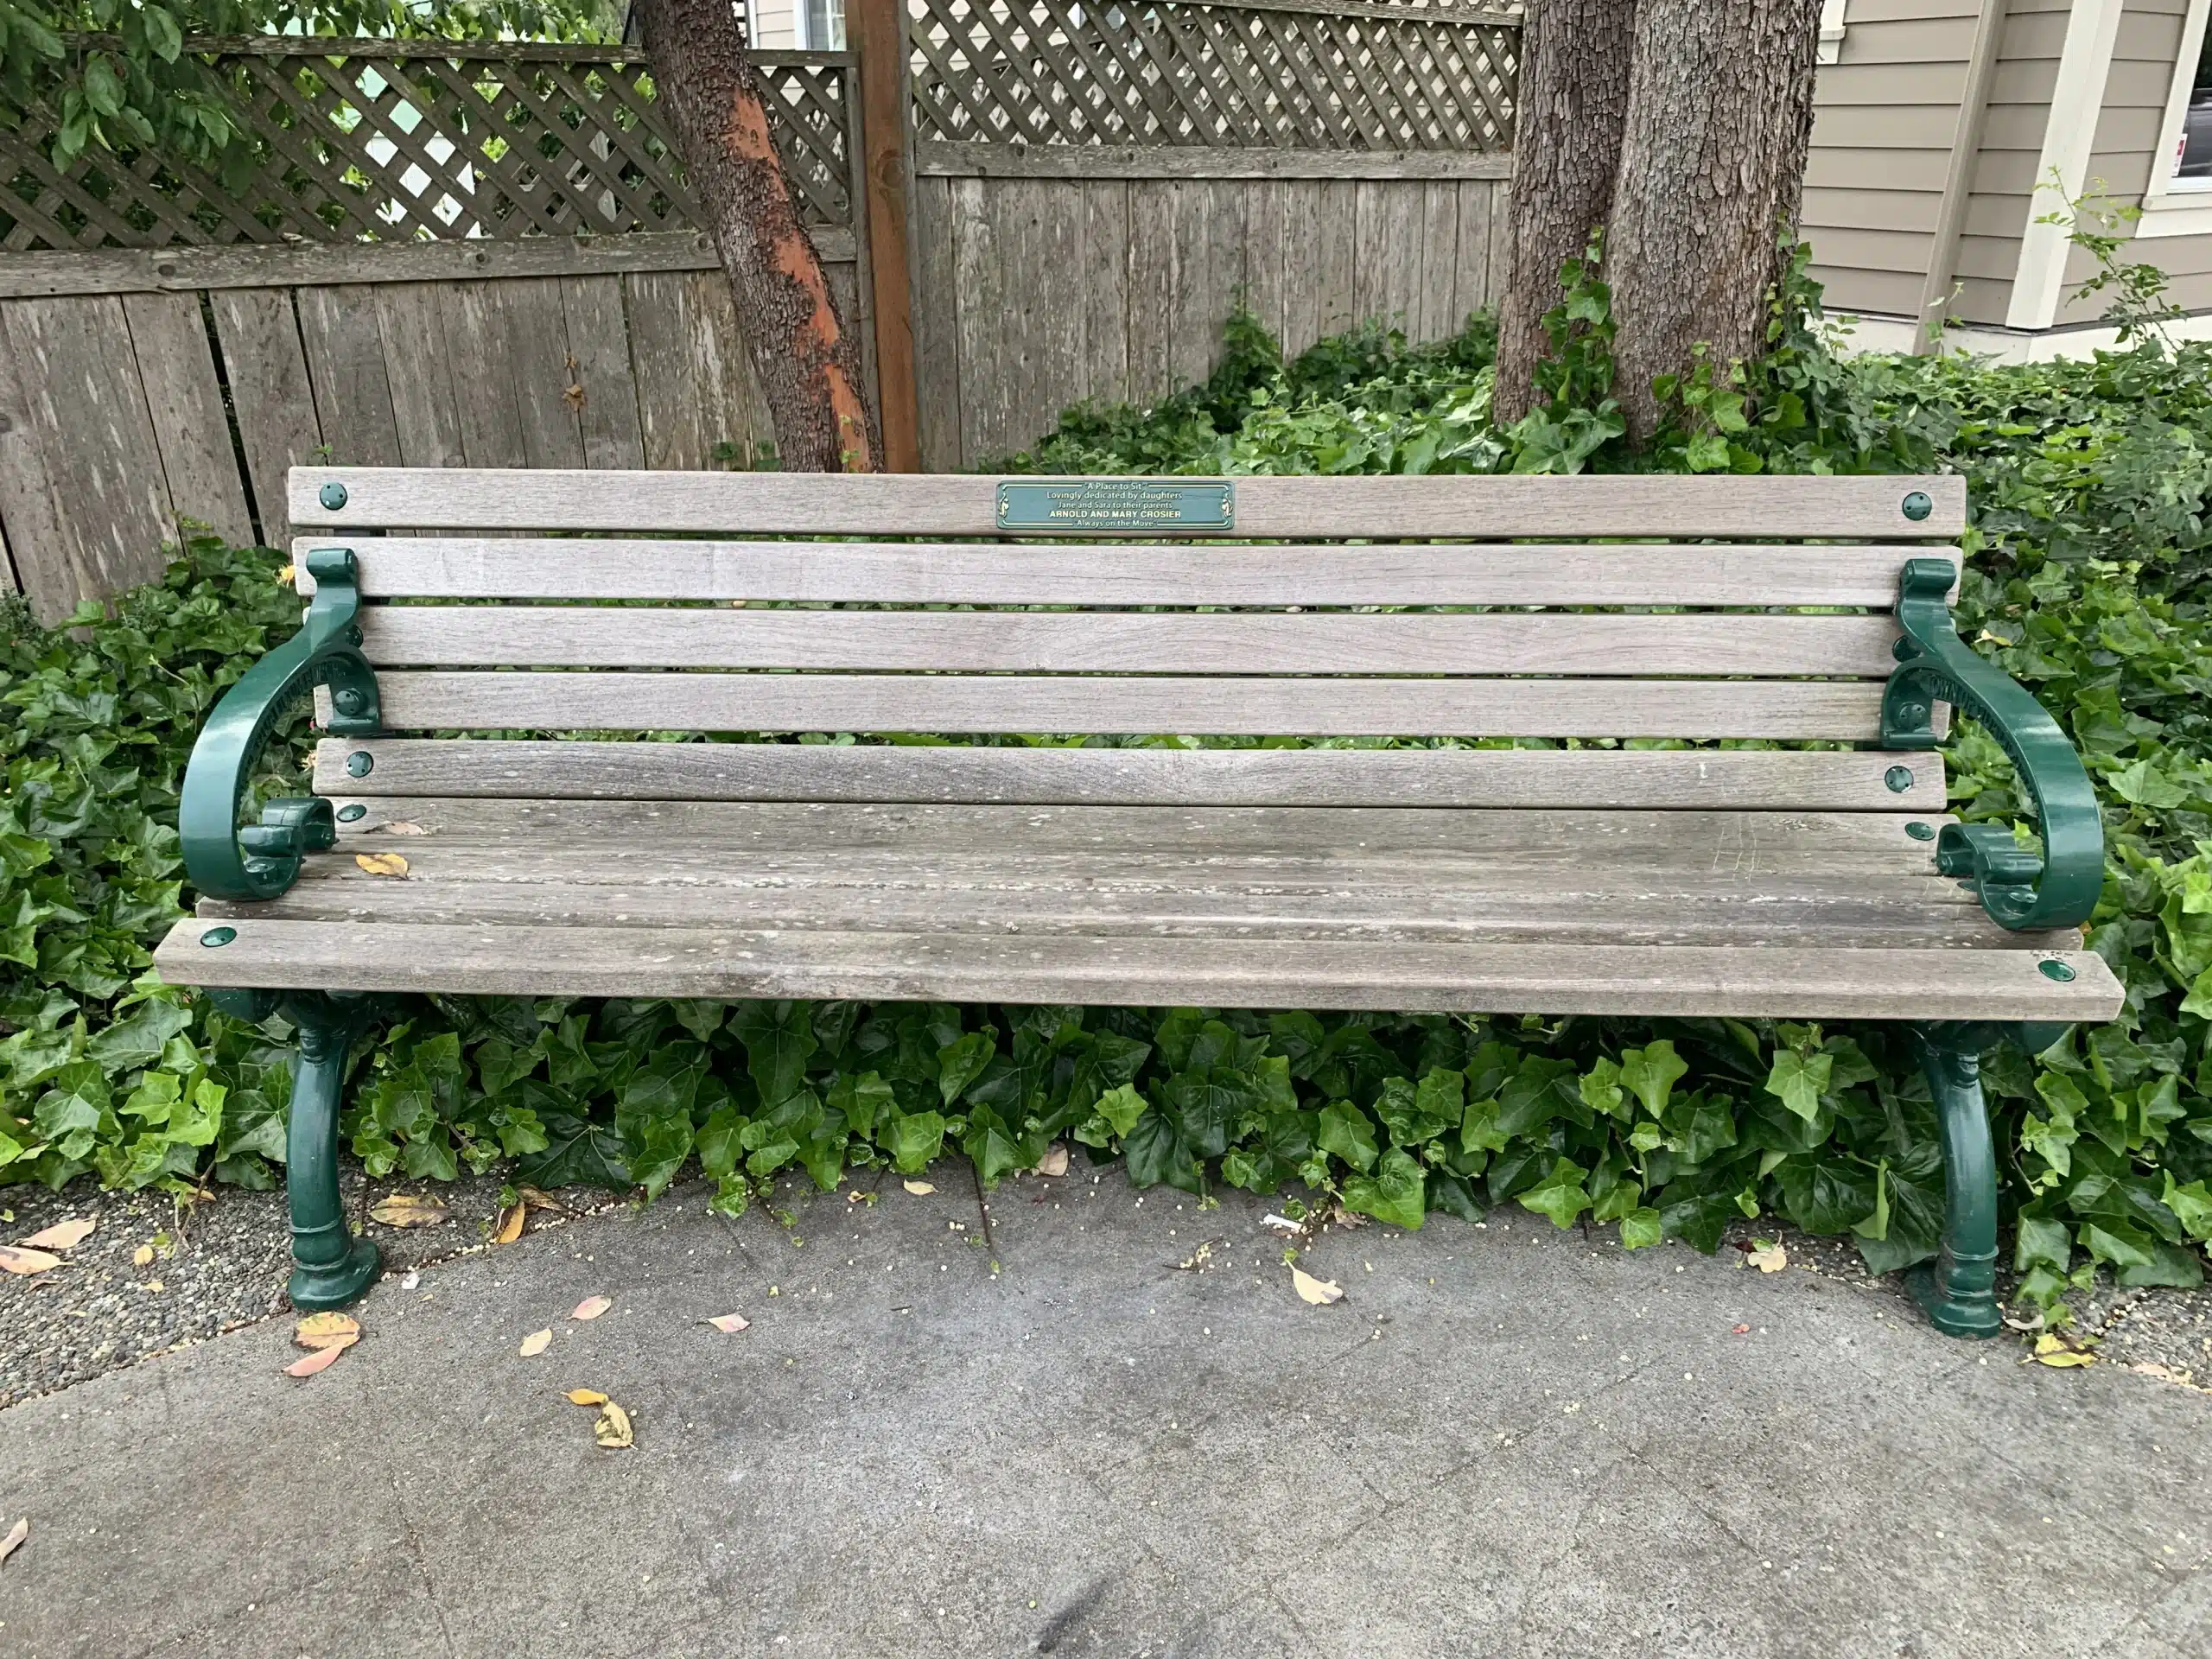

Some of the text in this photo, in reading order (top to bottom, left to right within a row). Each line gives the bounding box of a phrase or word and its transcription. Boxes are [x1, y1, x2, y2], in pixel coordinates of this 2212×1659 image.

[1046, 491, 1183, 501] Lovingly dedicated by daughters
[1049, 510, 1181, 518] ARNOLD AND MARY CROSIER
